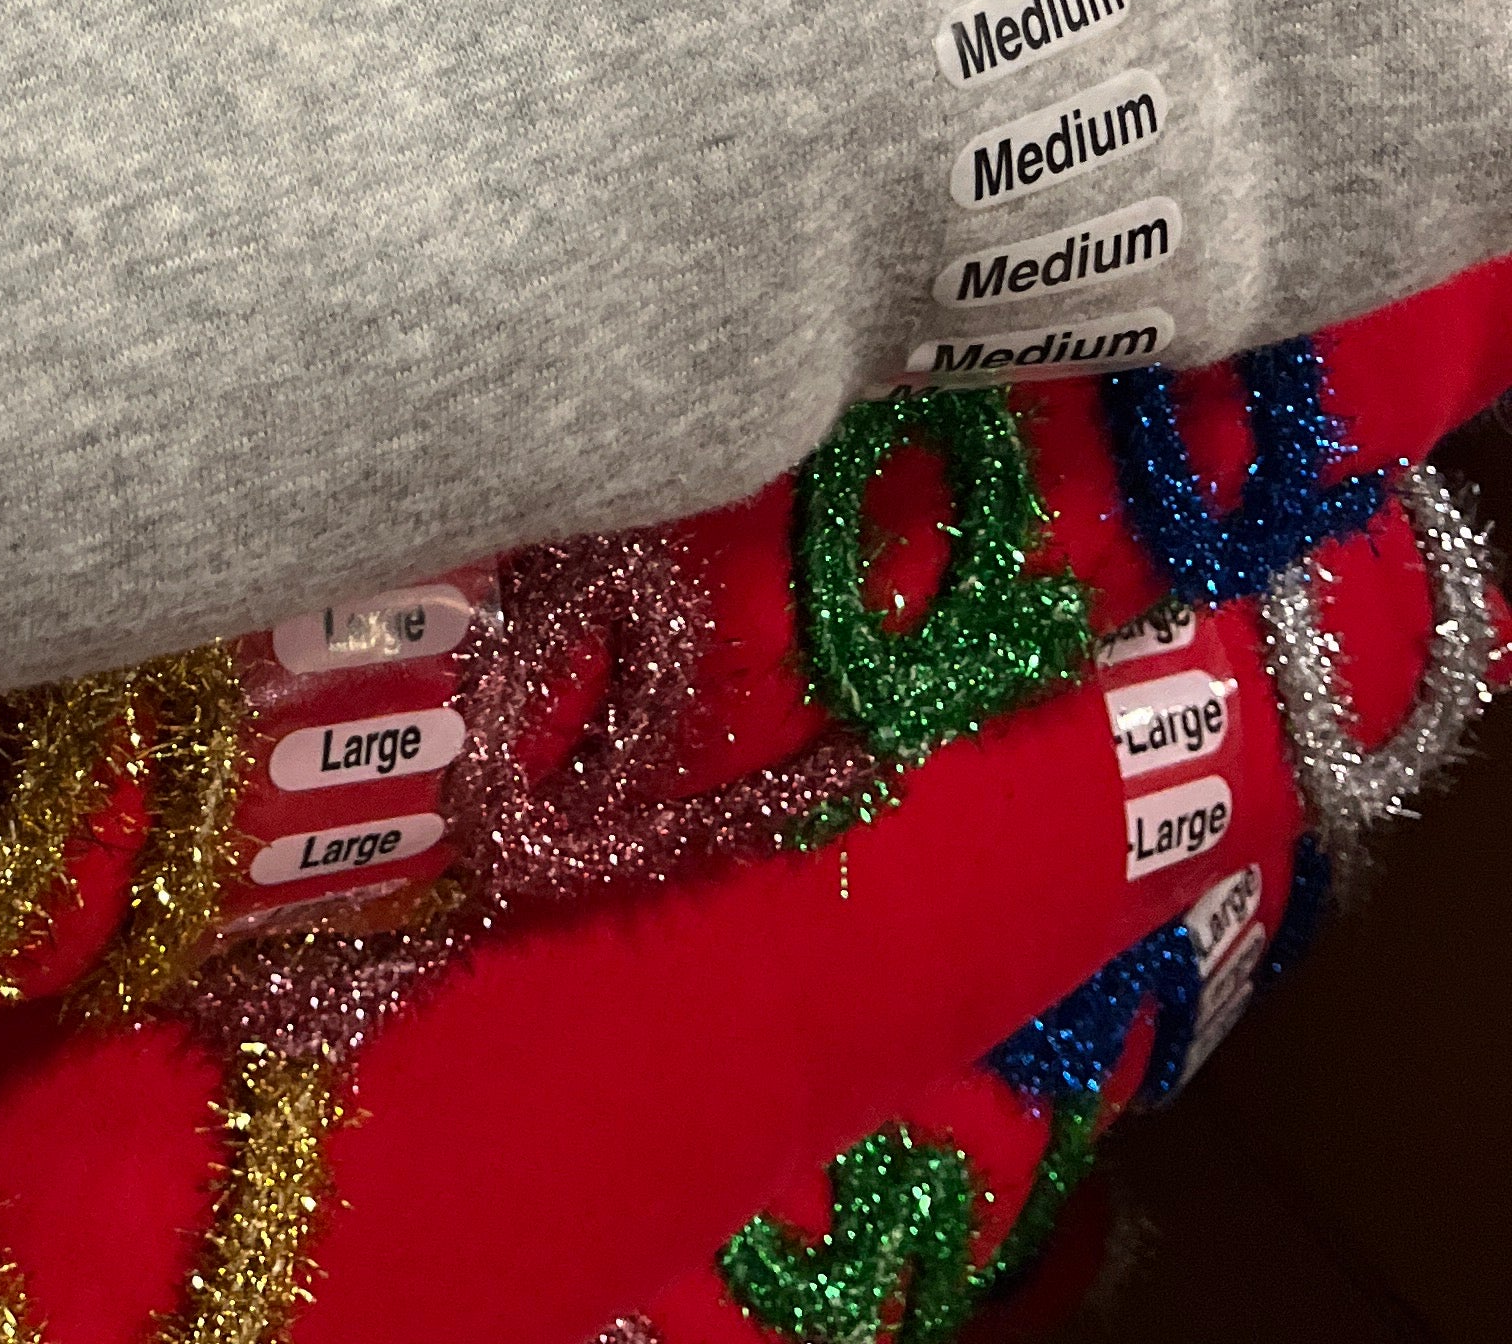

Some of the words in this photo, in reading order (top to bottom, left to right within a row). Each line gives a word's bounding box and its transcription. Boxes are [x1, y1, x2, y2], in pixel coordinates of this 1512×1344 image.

[973, 92, 1159, 202] Medium
[955, 216, 1170, 302] Medium
[931, 324, 1159, 373] Medium
[320, 723, 422, 775] Large
[299, 827, 403, 871] Large
